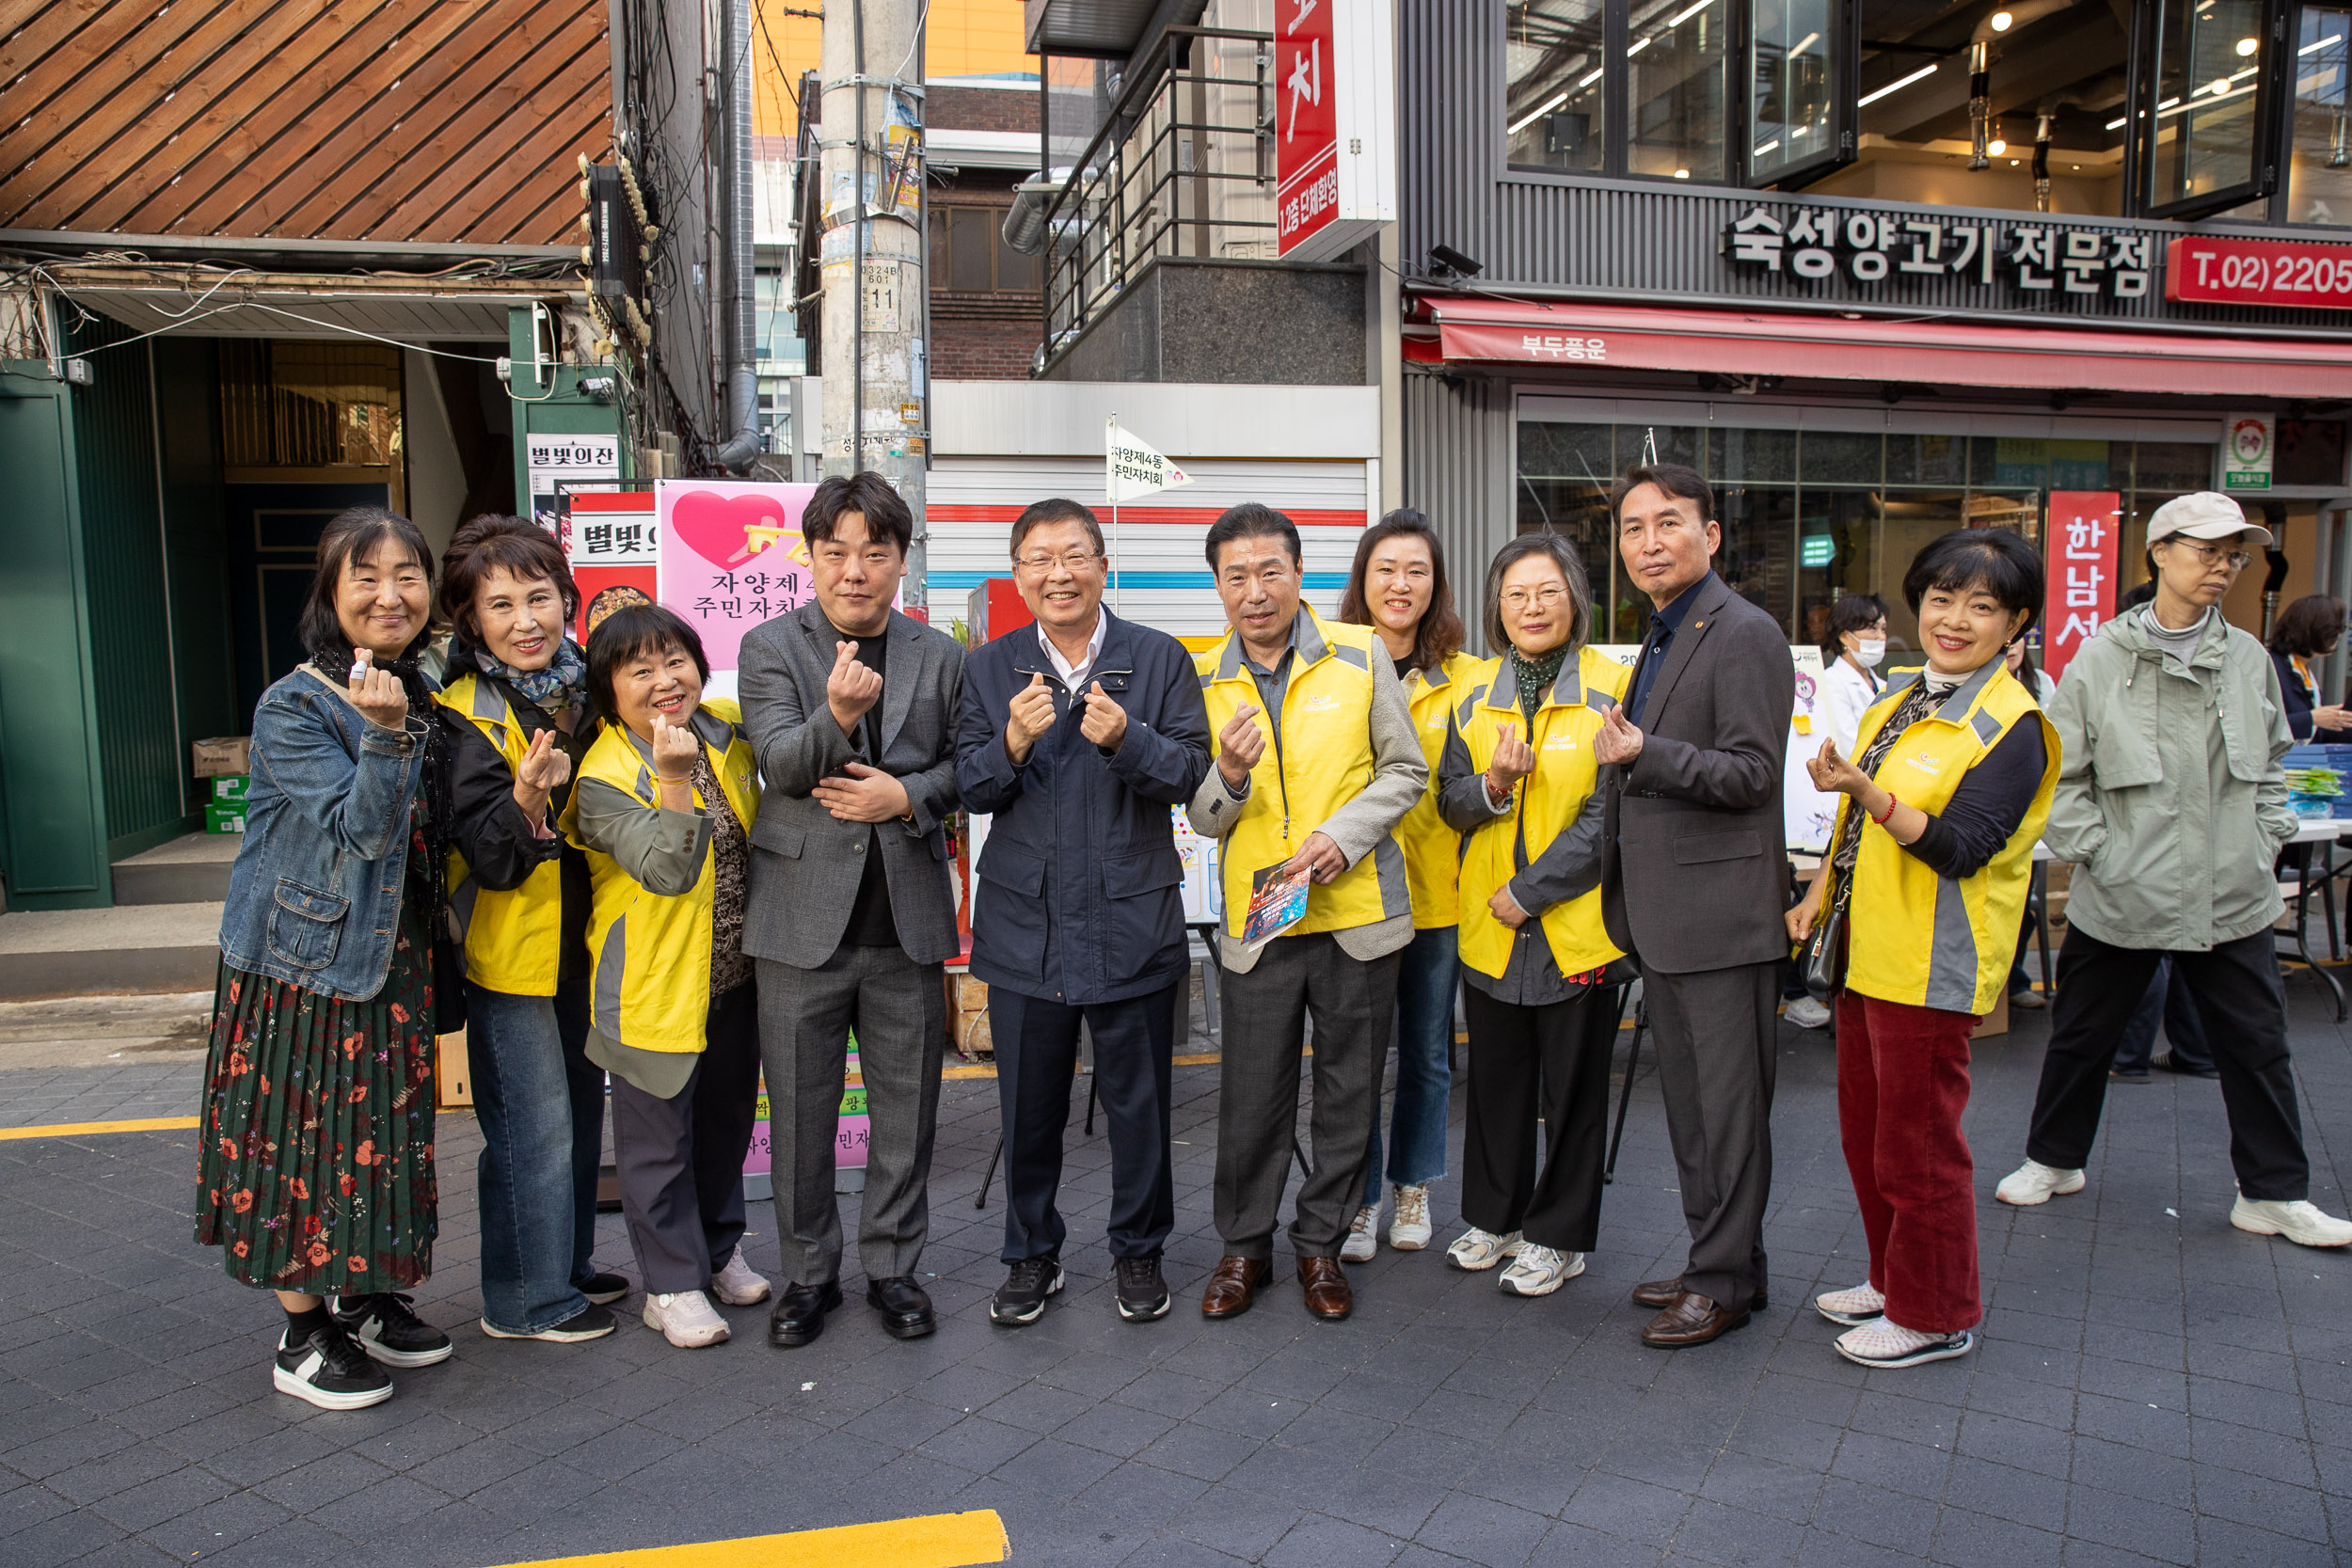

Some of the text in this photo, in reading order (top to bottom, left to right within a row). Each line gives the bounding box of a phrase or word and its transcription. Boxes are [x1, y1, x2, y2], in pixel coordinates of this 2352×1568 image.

[1300, 167, 1337, 225] 단체환영
[1732, 206, 2152, 298] 숙성양고기 전문점
[868, 276, 888, 284] 601
[1522, 335, 1606, 360] 부두풍운
[1111, 446, 1163, 469] 자양제4동
[1111, 464, 1163, 486] 주민자치회
[692, 595, 813, 620] 주민자치
[846, 1096, 866, 1111] 팡
